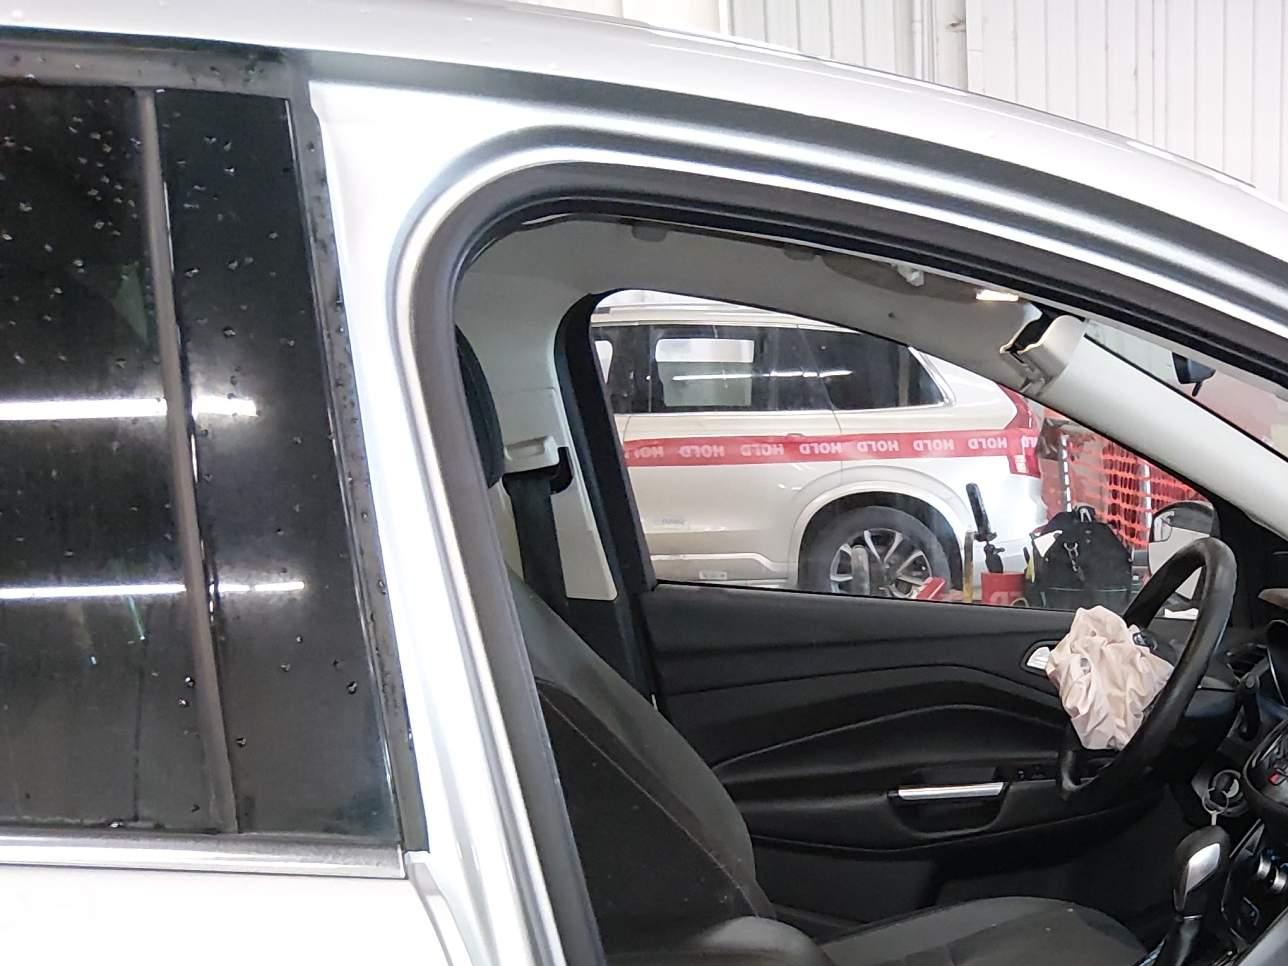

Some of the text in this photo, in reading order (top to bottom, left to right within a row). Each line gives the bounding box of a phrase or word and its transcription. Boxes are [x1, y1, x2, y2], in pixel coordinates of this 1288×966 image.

[740, 443, 784, 457] HOLD
[800, 442, 842, 455] HOLD
[857, 440, 899, 453] HOLD
[913, 438, 954, 452] HOLD
[968, 437, 1007, 450] HOLD
[679, 444, 725, 459] HOLD
